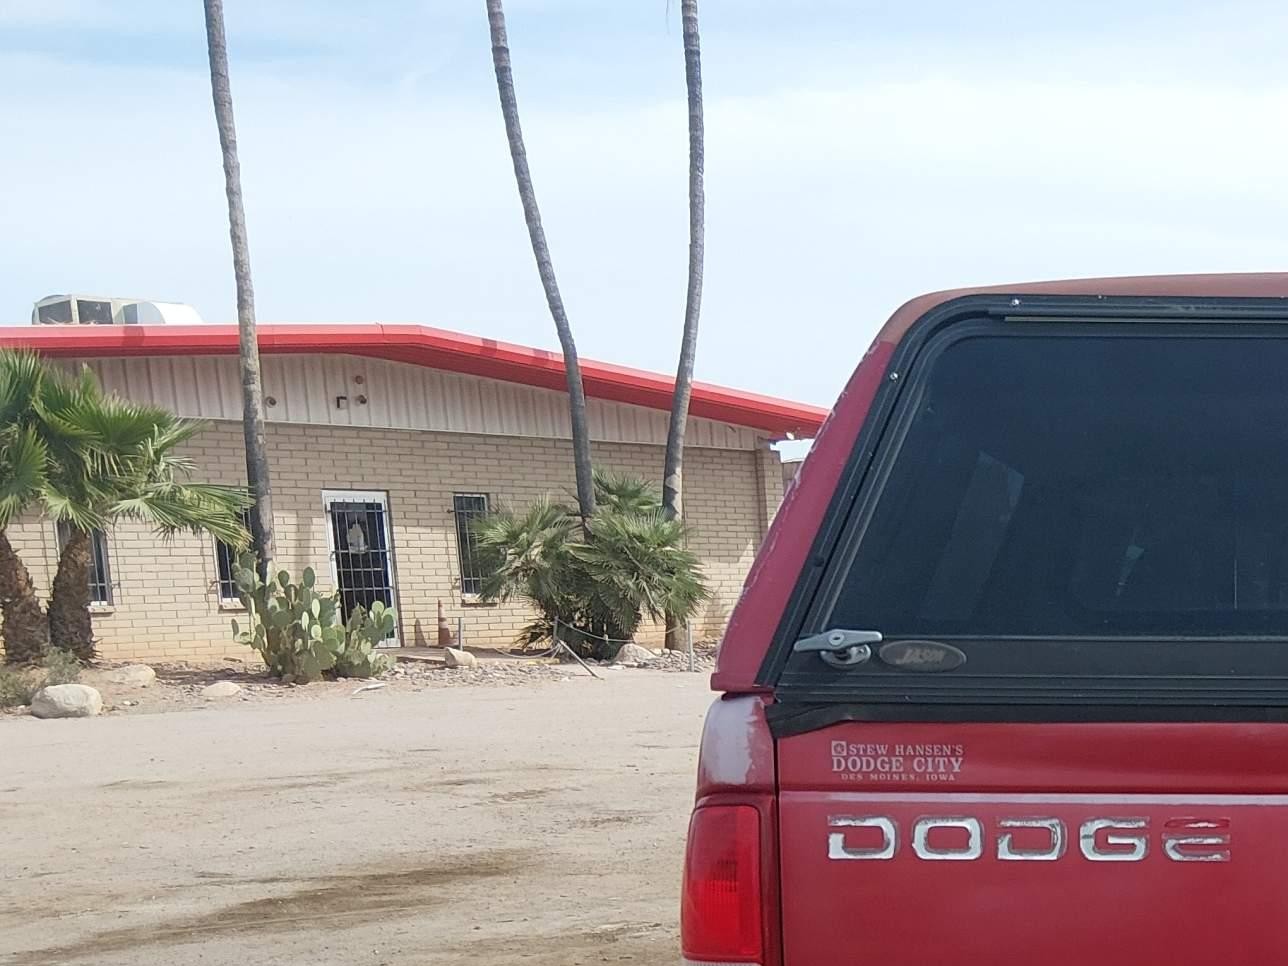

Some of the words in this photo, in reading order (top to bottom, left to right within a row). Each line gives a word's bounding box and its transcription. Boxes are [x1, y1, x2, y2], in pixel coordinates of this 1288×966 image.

[849, 744, 889, 756] STEW
[895, 744, 964, 756] HANSEN'S
[832, 756, 904, 772] DODGE
[913, 756, 964, 773] CITY
[841, 773, 863, 781] DES
[926, 773, 955, 781] IOWA
[826, 815, 1232, 863] DODGE
